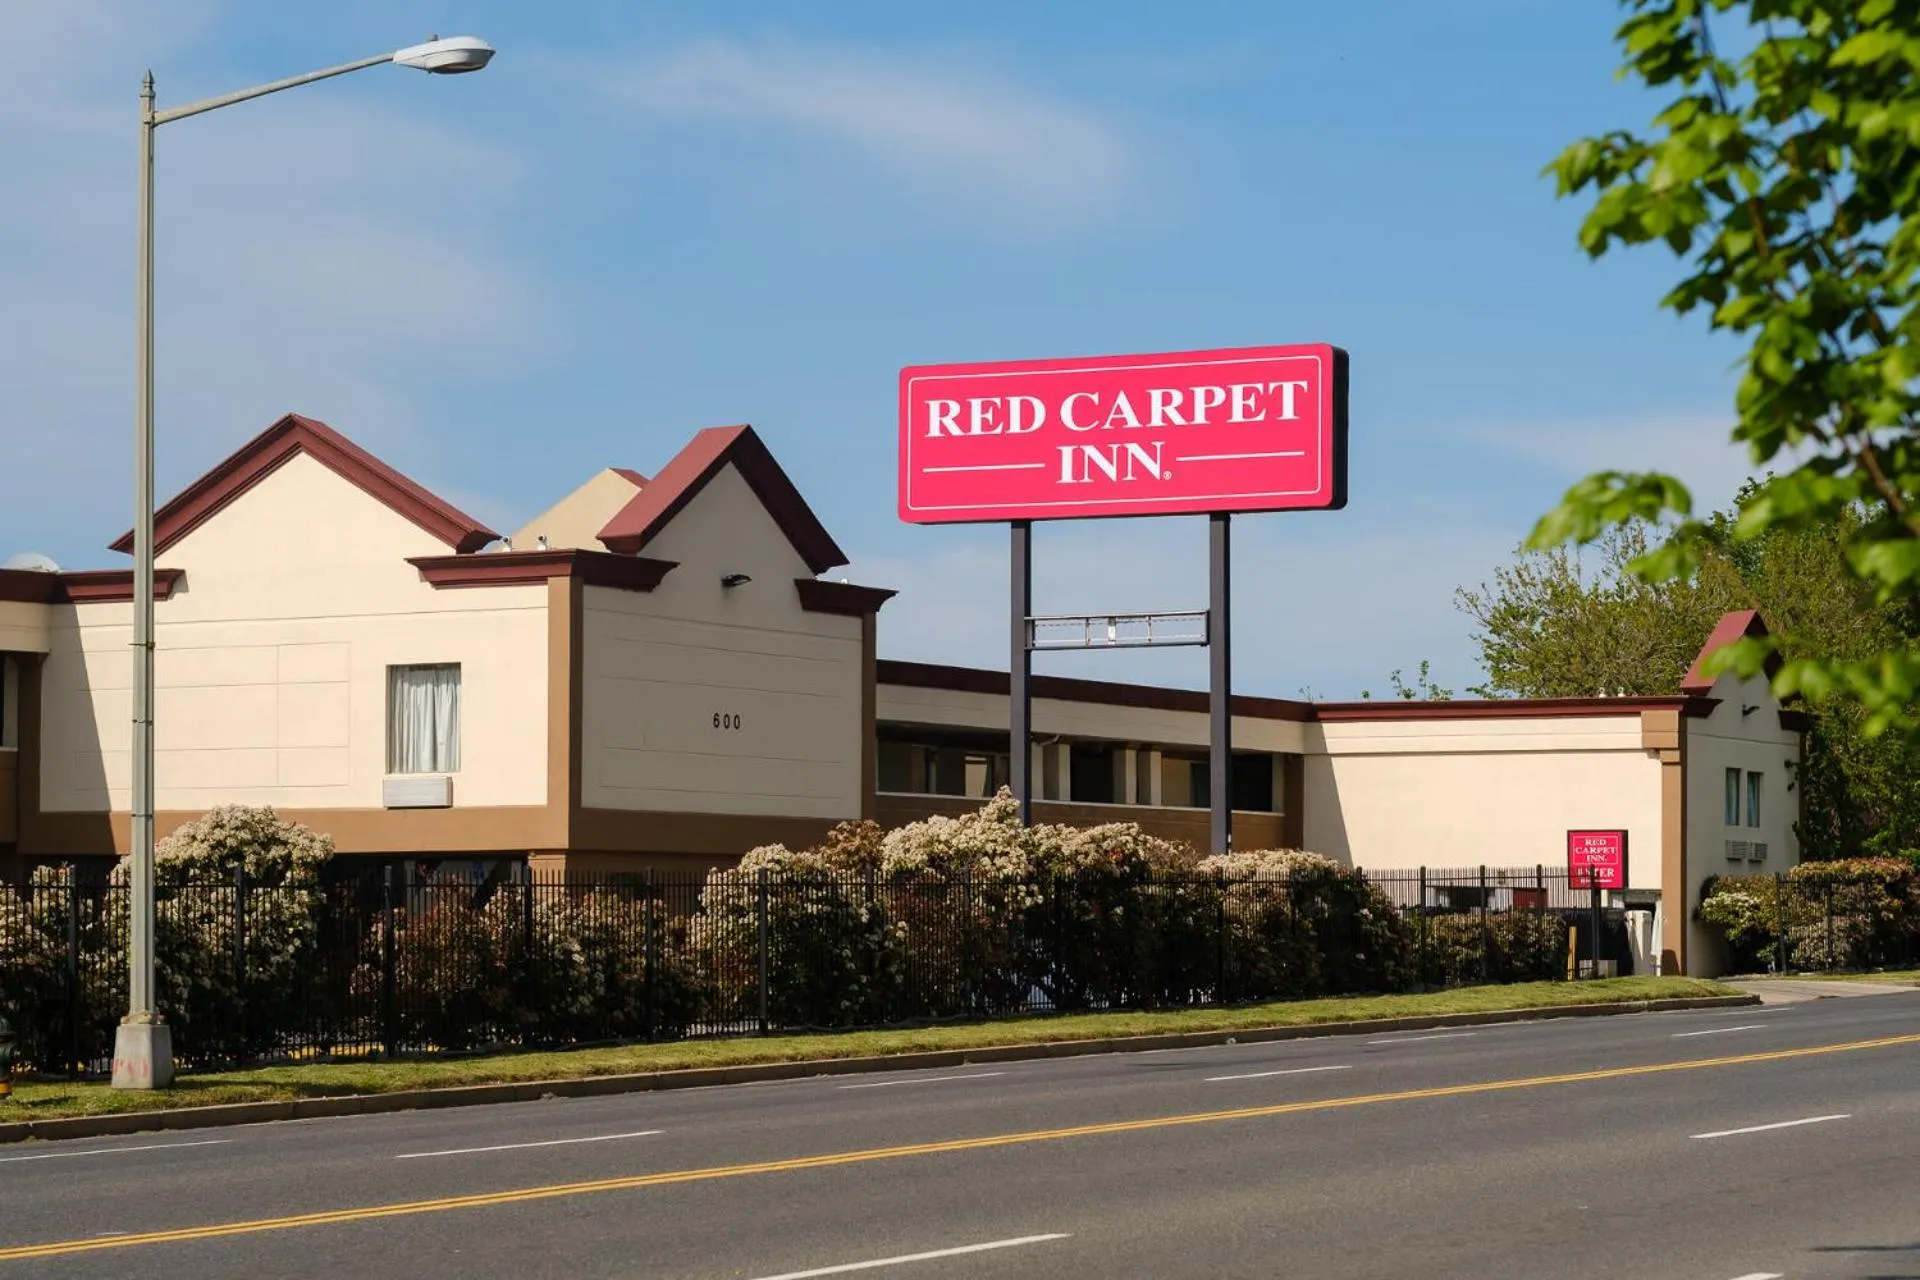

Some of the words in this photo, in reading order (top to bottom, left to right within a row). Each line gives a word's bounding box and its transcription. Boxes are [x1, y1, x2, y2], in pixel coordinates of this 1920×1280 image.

[923, 394, 1046, 438] RED
[1060, 380, 1308, 433] CARPET
[713, 713, 741, 730] 600
